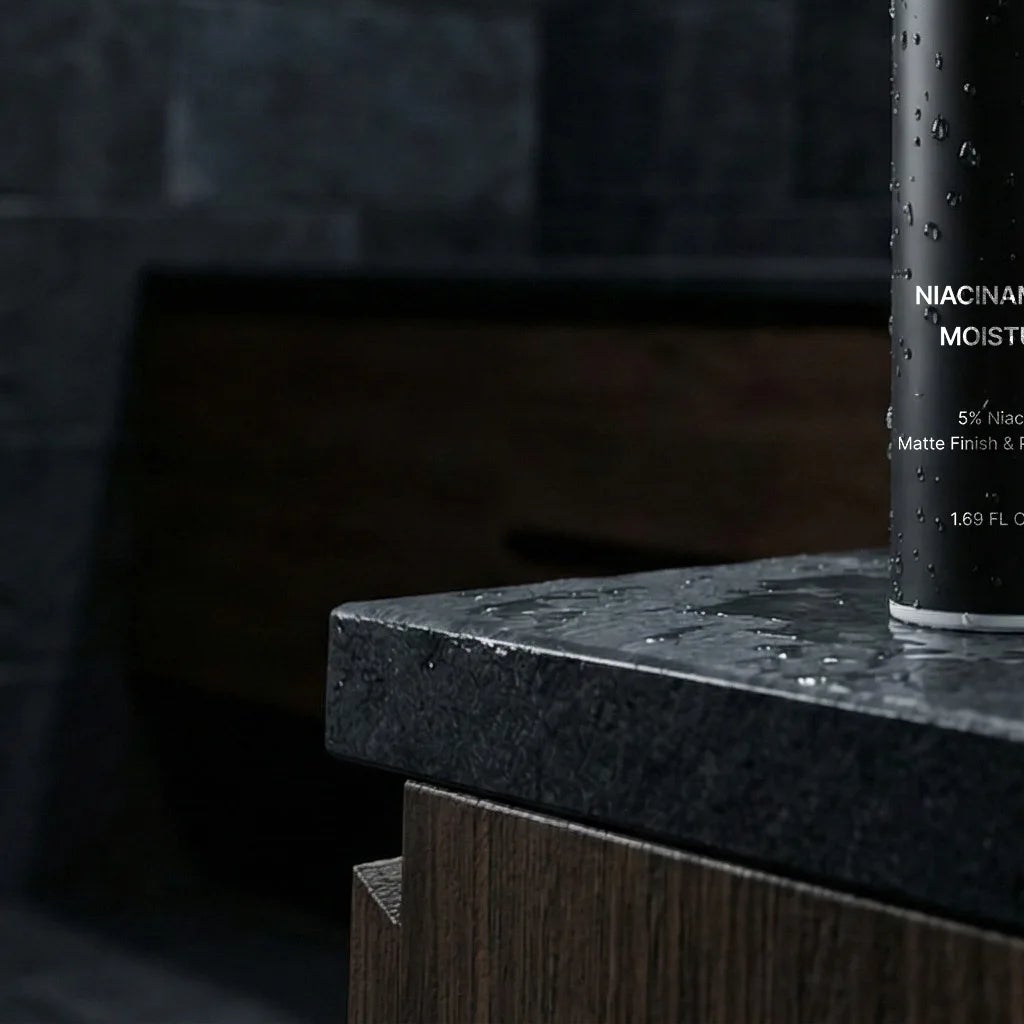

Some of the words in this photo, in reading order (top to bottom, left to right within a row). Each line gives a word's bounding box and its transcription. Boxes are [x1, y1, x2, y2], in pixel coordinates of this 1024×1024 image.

[958, 410, 982, 425] 5%
[898, 436, 945, 451] Matte
[950, 436, 998, 451] Finish
[1003, 437, 1014, 451] &
[950, 512, 983, 526] 1.69
[989, 512, 1008, 526] FL
